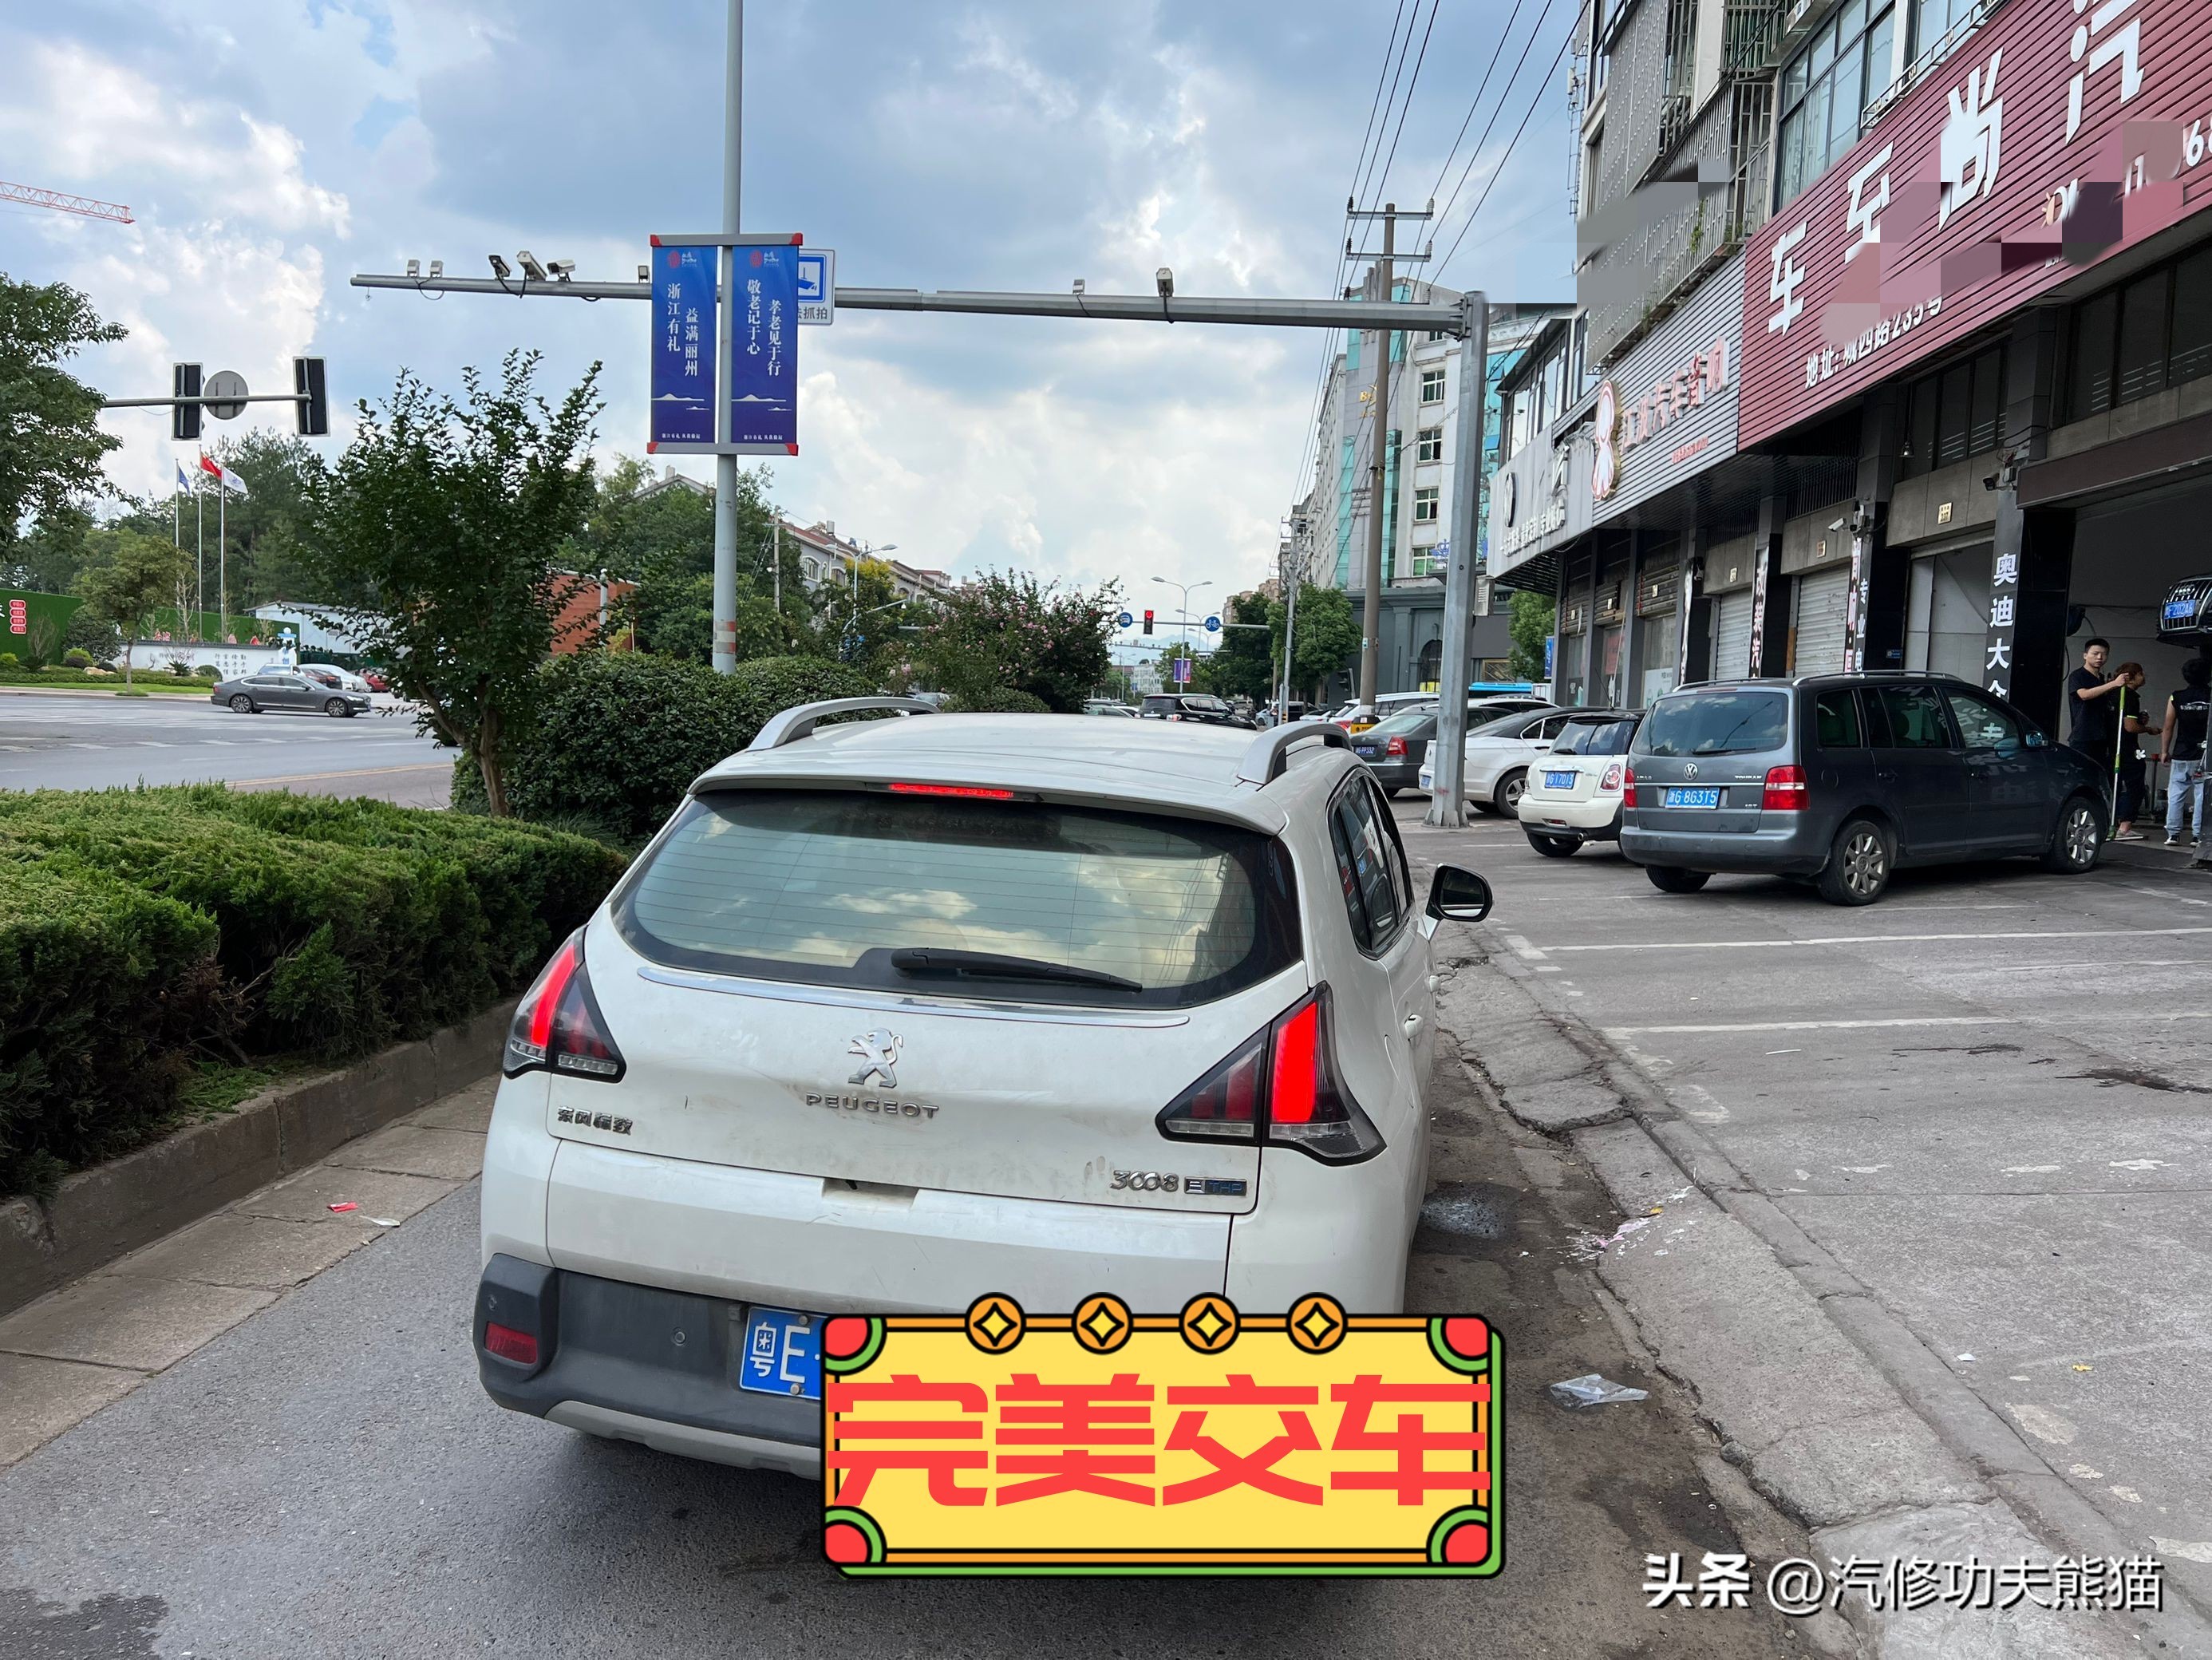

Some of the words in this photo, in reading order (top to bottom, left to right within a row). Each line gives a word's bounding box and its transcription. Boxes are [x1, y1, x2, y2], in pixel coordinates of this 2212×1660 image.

[667, 283, 681, 352] 浙江有礼
[685, 307, 698, 377] 益满丽州
[747, 279, 760, 355] 敬老记于心
[768, 299, 781, 376] 孝老见于行
[558, 1105, 633, 1136] 东风标致
[806, 1093, 939, 1119] PEUGEOT
[1109, 1169, 1179, 1192] 3008
